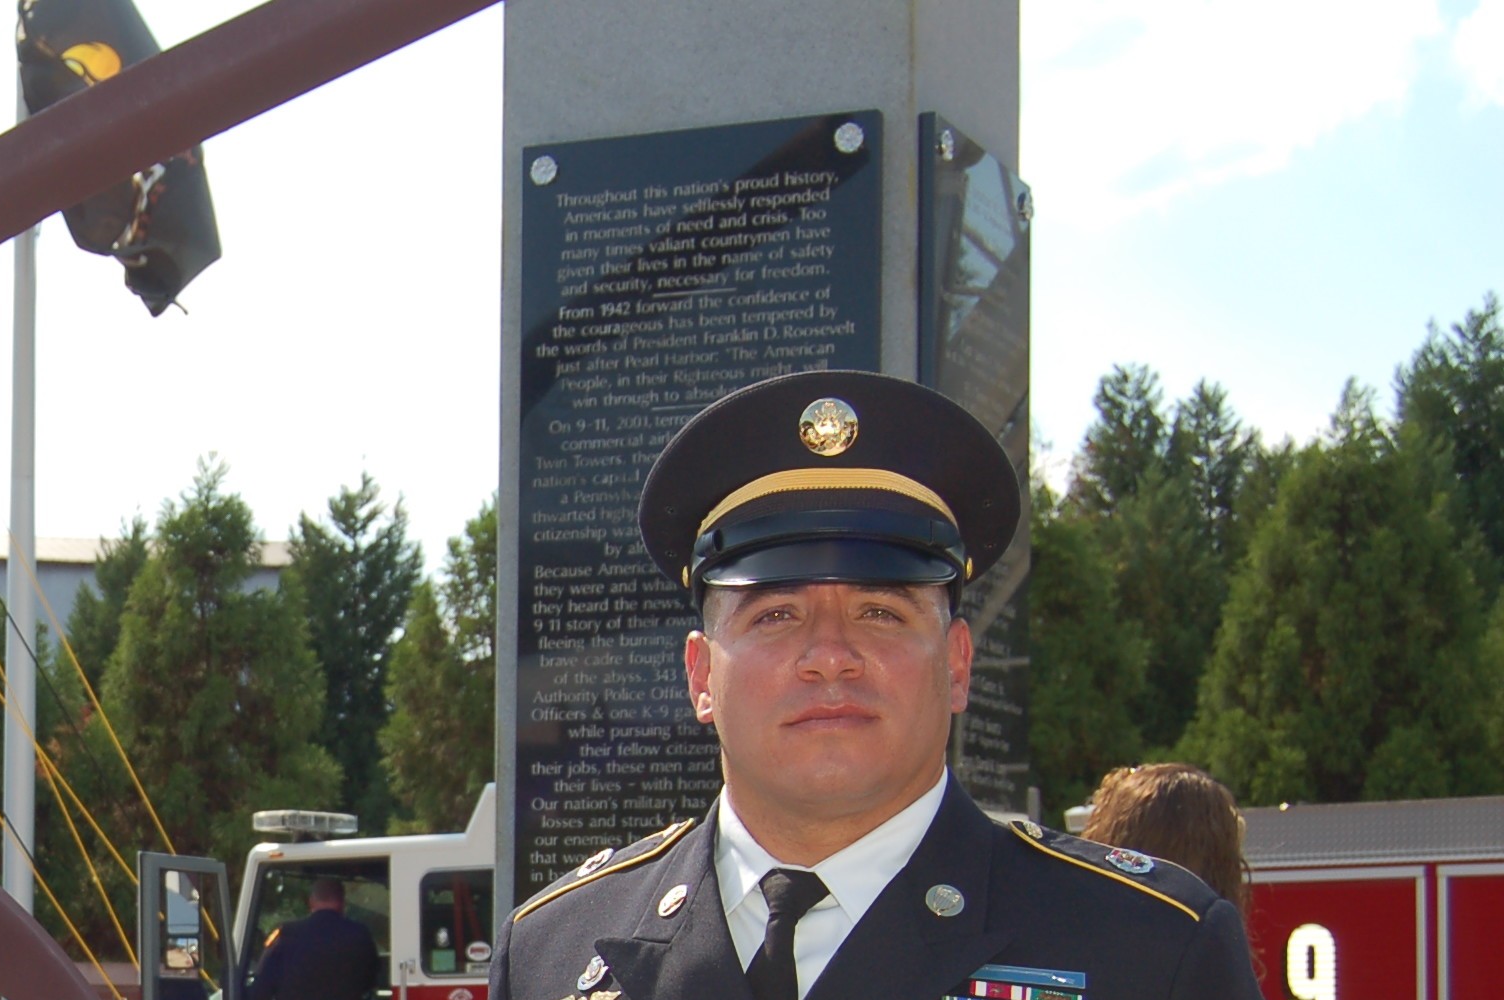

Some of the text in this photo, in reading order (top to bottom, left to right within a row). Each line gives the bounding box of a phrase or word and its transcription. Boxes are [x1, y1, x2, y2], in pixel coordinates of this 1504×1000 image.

[556, 188, 637, 208] Throughout
[643, 184, 667, 199] this
[673, 178, 729, 196] nation's
[735, 172, 779, 194] proud
[563, 186, 830, 224] Americans have selflessly responded
[560, 248, 599, 260] many
[649, 237, 695, 252] valiant
[701, 230, 790, 248] countrymen
[795, 225, 831, 239] have
[565, 229, 578, 242] in
[583, 224, 650, 240] moments
[655, 219, 670, 234] of
[676, 215, 713, 232] need
[719, 212, 746, 228] and
[557, 243, 834, 282] given their lives in the name of safety
[560, 262, 830, 296] and security, necessary for freedom.
[558, 284, 830, 320] From 1942 forward the confidence of
[552, 303, 838, 338] the courageous has been tempered by
[539, 650, 674, 668] brave cadre fought
[531, 759, 714, 778] their jobs, these men and
[530, 795, 705, 810] Our nation's military has
